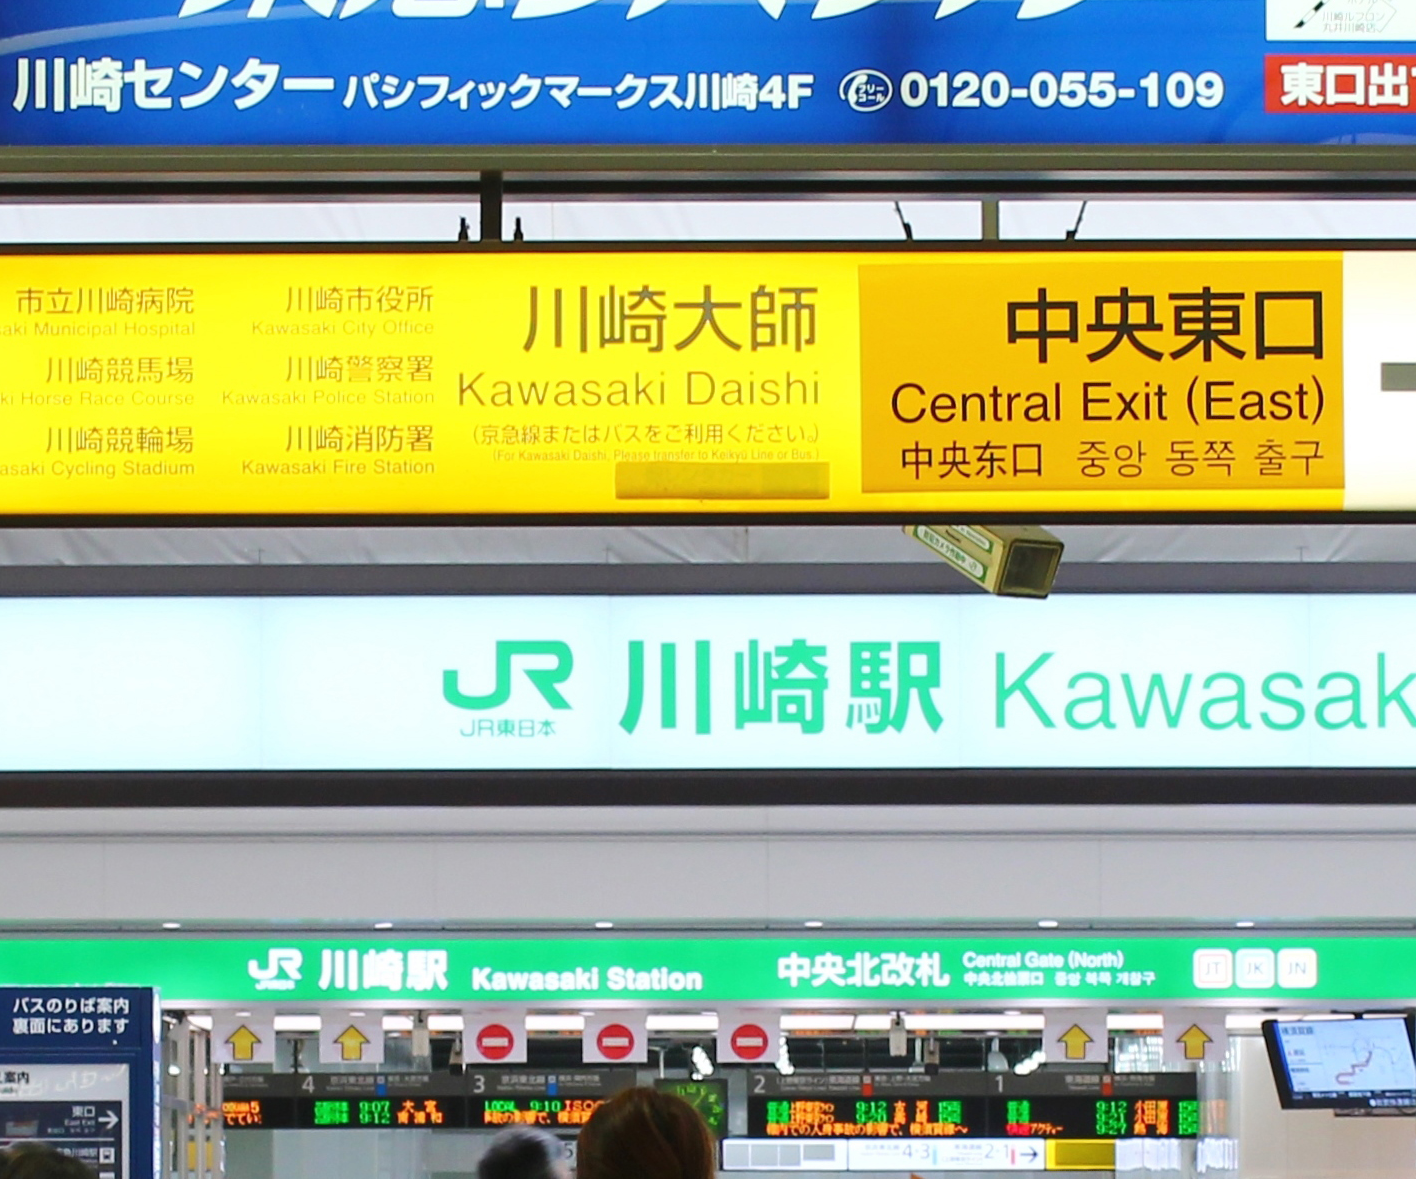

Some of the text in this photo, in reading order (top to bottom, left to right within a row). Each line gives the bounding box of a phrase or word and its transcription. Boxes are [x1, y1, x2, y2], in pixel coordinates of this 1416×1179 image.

[13, 56, 1224, 114] 川崎センター パシフィックマークス川崎4F 0120-055-109
[16, 287, 194, 315] 市立川崎病院
[286, 286, 434, 314] 川崎市役所
[252, 319, 435, 338] Kawasaki City Office
[523, 284, 818, 353] 川崎大師
[1006, 287, 1325, 363] 中央東口
[35, 321, 119, 340] Municipal
[124, 321, 195, 339] Hospital
[46, 357, 194, 385] 川崎競馬場
[286, 355, 434, 384] 川崎警察署
[21, 390, 73, 407] Horse
[80, 390, 125, 407] Race
[131, 390, 195, 407] Course
[222, 390, 435, 406] Kawasaki Police Station
[457, 371, 819, 407] Kawasaki Daishi
[890, 379, 1325, 427] Central Exit (East)
[46, 426, 194, 454] 川崎競輪場
[286, 425, 434, 453] 川崎消防署
[242, 460, 435, 476] Kawasaki Fire Station
[901, 441, 1044, 480] 中央东口
[1076, 439, 1325, 479] 중앙 동쪽 출구
[51, 461, 115, 480] Cycling
[122, 461, 195, 477] Stadium
[443, 640, 573, 710] JR
[618, 638, 944, 736] 川崎駅
[460, 718, 557, 738] JR東日本
[247, 948, 703, 991] JR 川崎駅 Kawasaki Station
[777, 951, 950, 988] 中央北改札
[962, 950, 1125, 970] Central Gate (North)
[1204, 960, 1307, 976] JT JK JN
[14, 998, 129, 1015] バスのりば案内
[13, 1017, 129, 1035] 裏面にあります
[302, 1075, 315, 1094] 4
[473, 1075, 486, 1093] 3
[754, 1075, 766, 1094] 2
[72, 1106, 95, 1118] 東口
[359, 1101, 390, 1113] 9:07
[530, 1100, 560, 1112] 9:10
